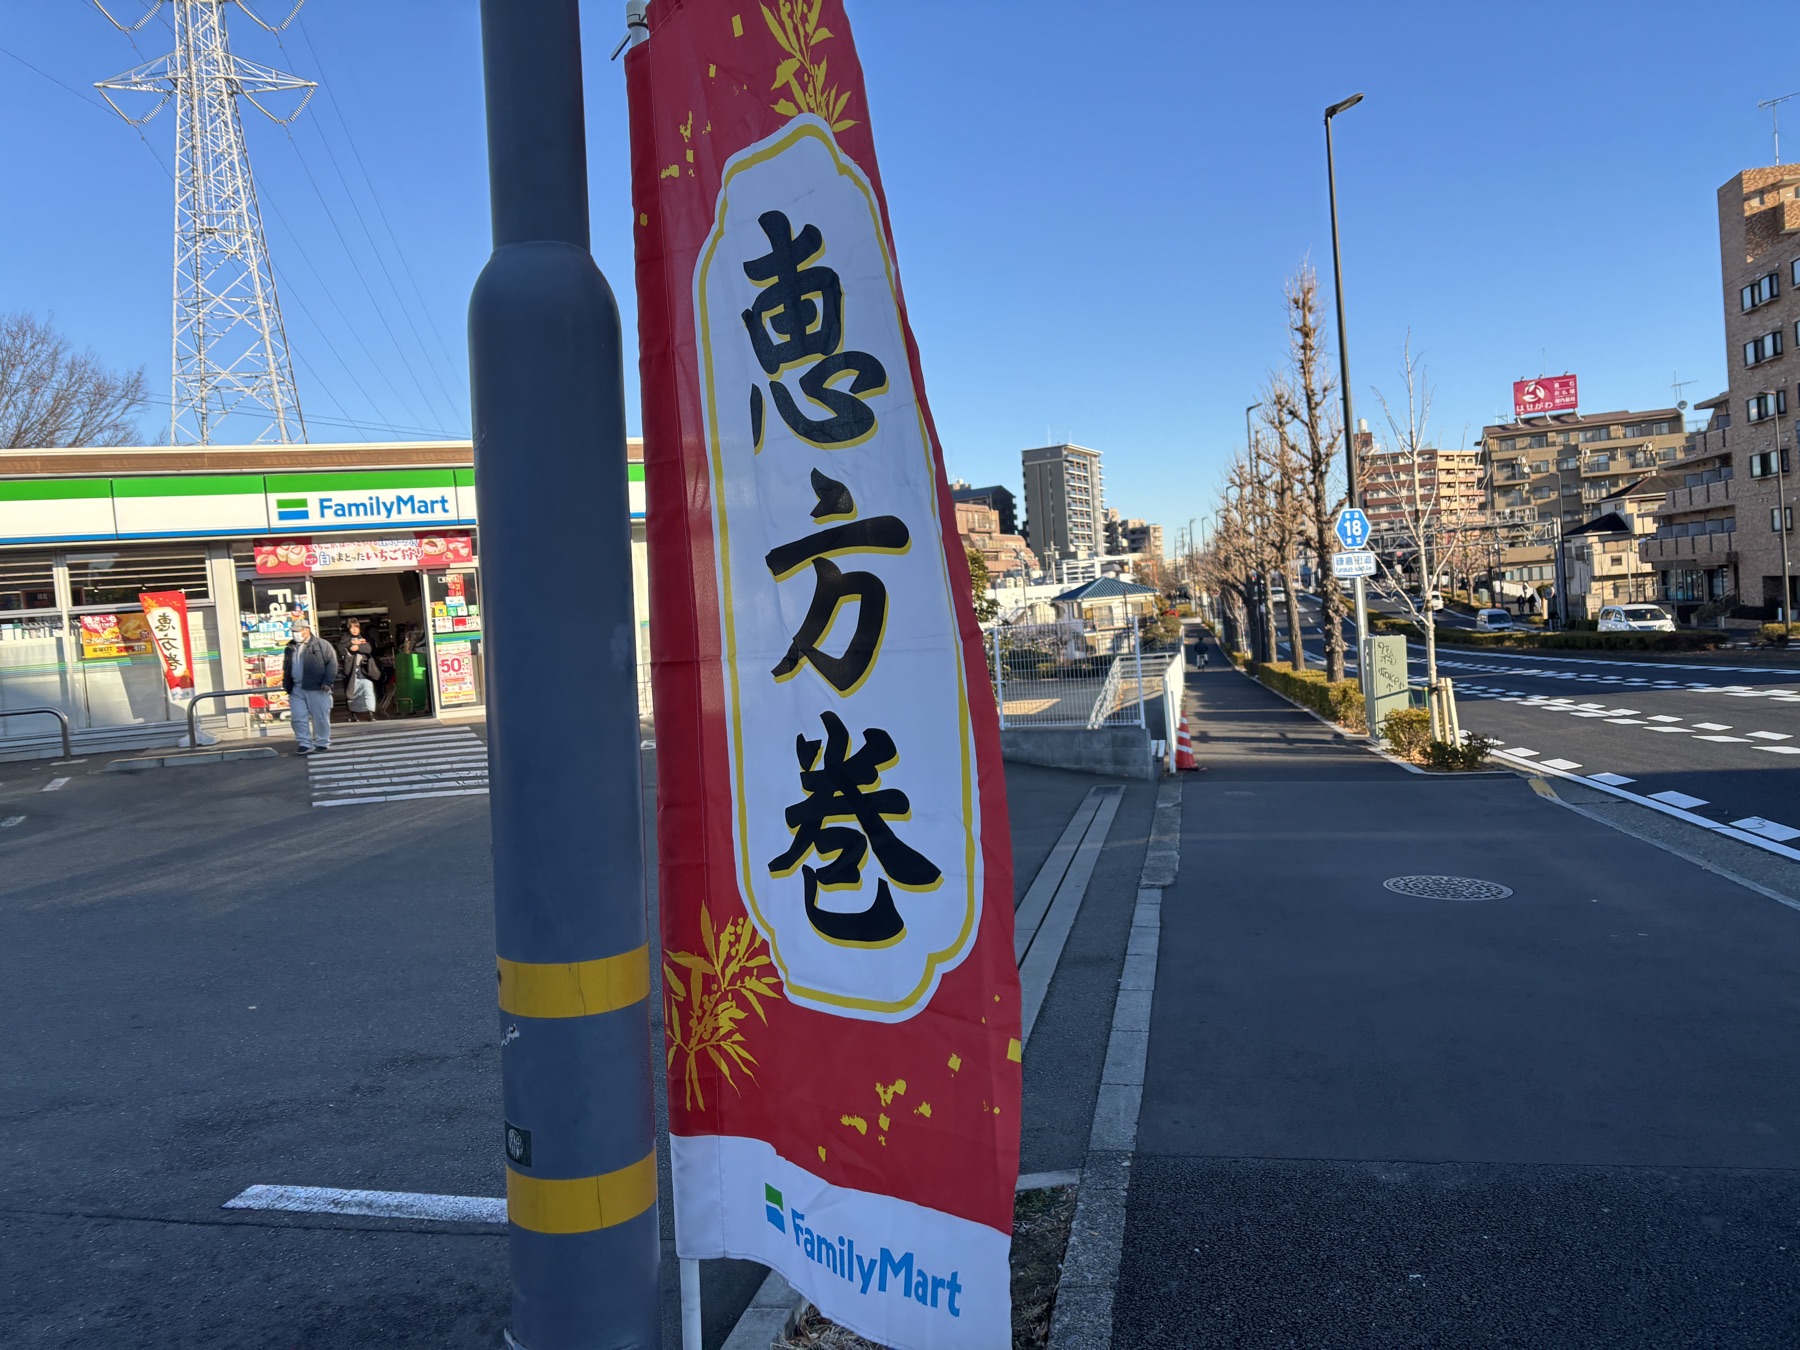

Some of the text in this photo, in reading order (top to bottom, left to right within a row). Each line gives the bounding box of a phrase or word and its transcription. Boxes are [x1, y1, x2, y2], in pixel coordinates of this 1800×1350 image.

[1516, 401, 1553, 412] はせがわ
[319, 494, 449, 518] FamilyMart
[1344, 519, 1362, 537] 18
[741, 210, 941, 950] 恵方巻
[440, 658, 462, 673] 50
[790, 1207, 962, 1318] FamilyMart
